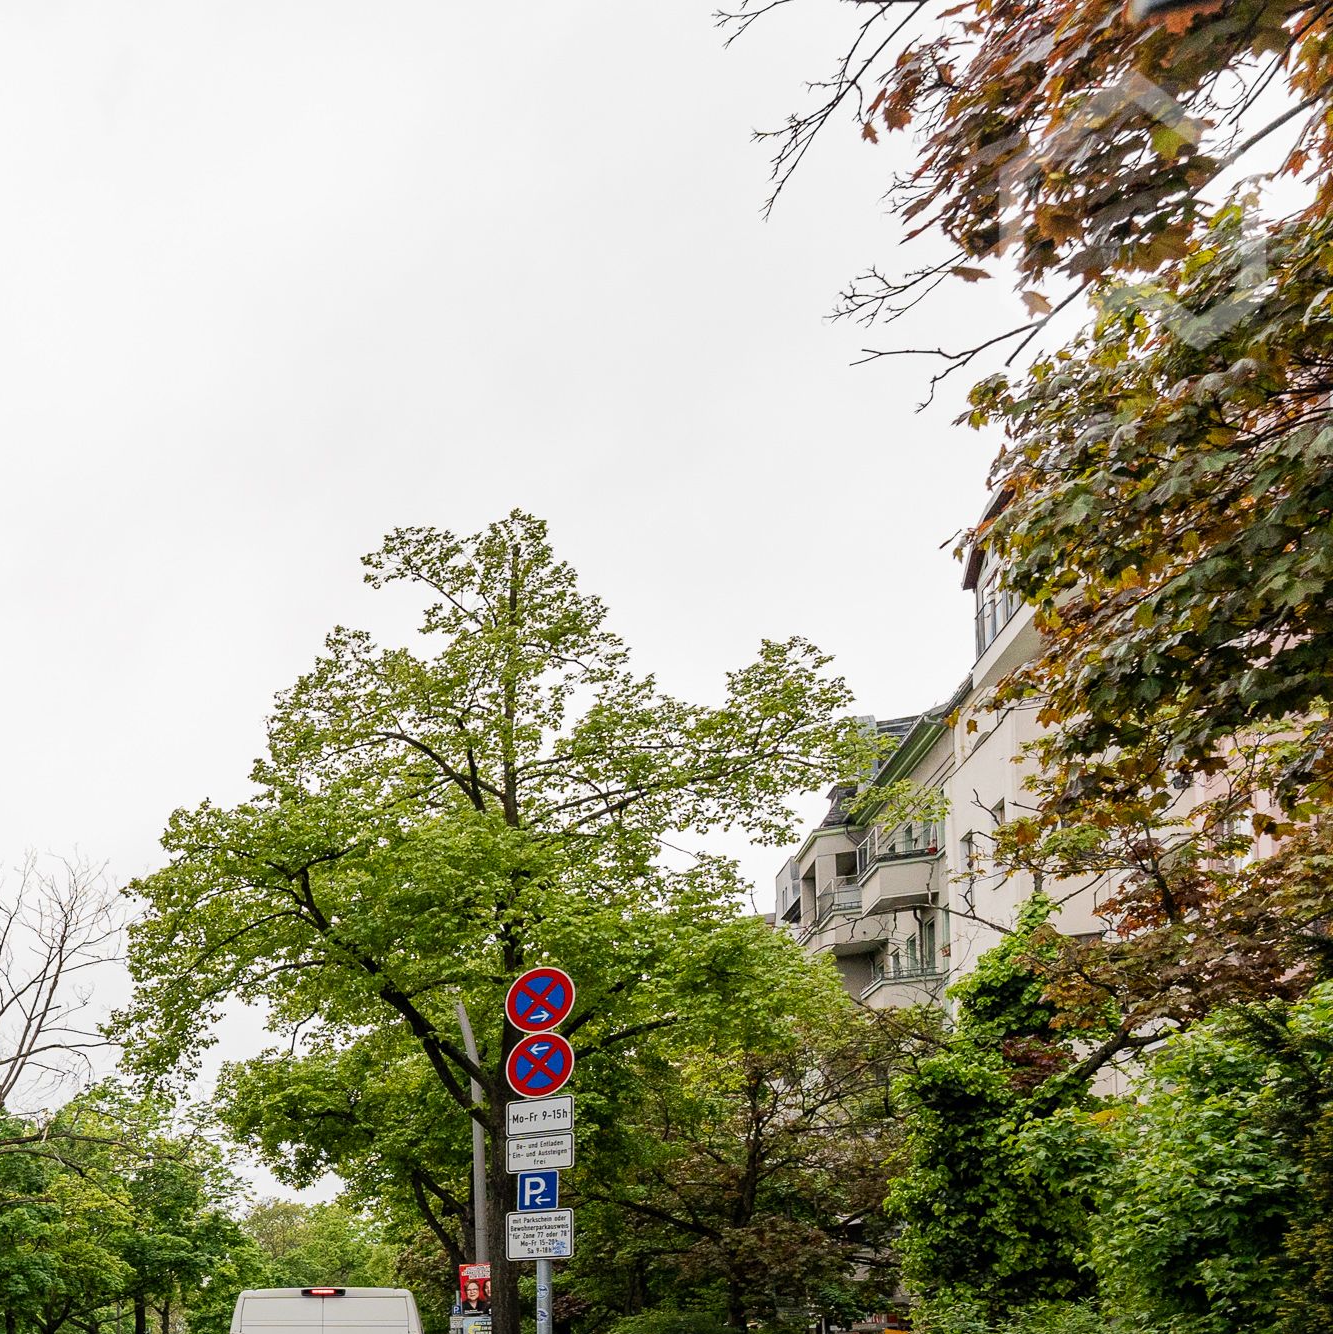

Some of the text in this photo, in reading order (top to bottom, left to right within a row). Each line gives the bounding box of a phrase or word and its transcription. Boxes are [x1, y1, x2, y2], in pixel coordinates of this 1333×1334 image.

[512, 1112, 538, 1124] Mo-Fr
[540, 1140, 564, 1148] Entladen
[538, 1148, 568, 1156] Aussteigen
[524, 1176, 546, 1206] P
[510, 1223, 569, 1232] Bewohnerparkausweis
